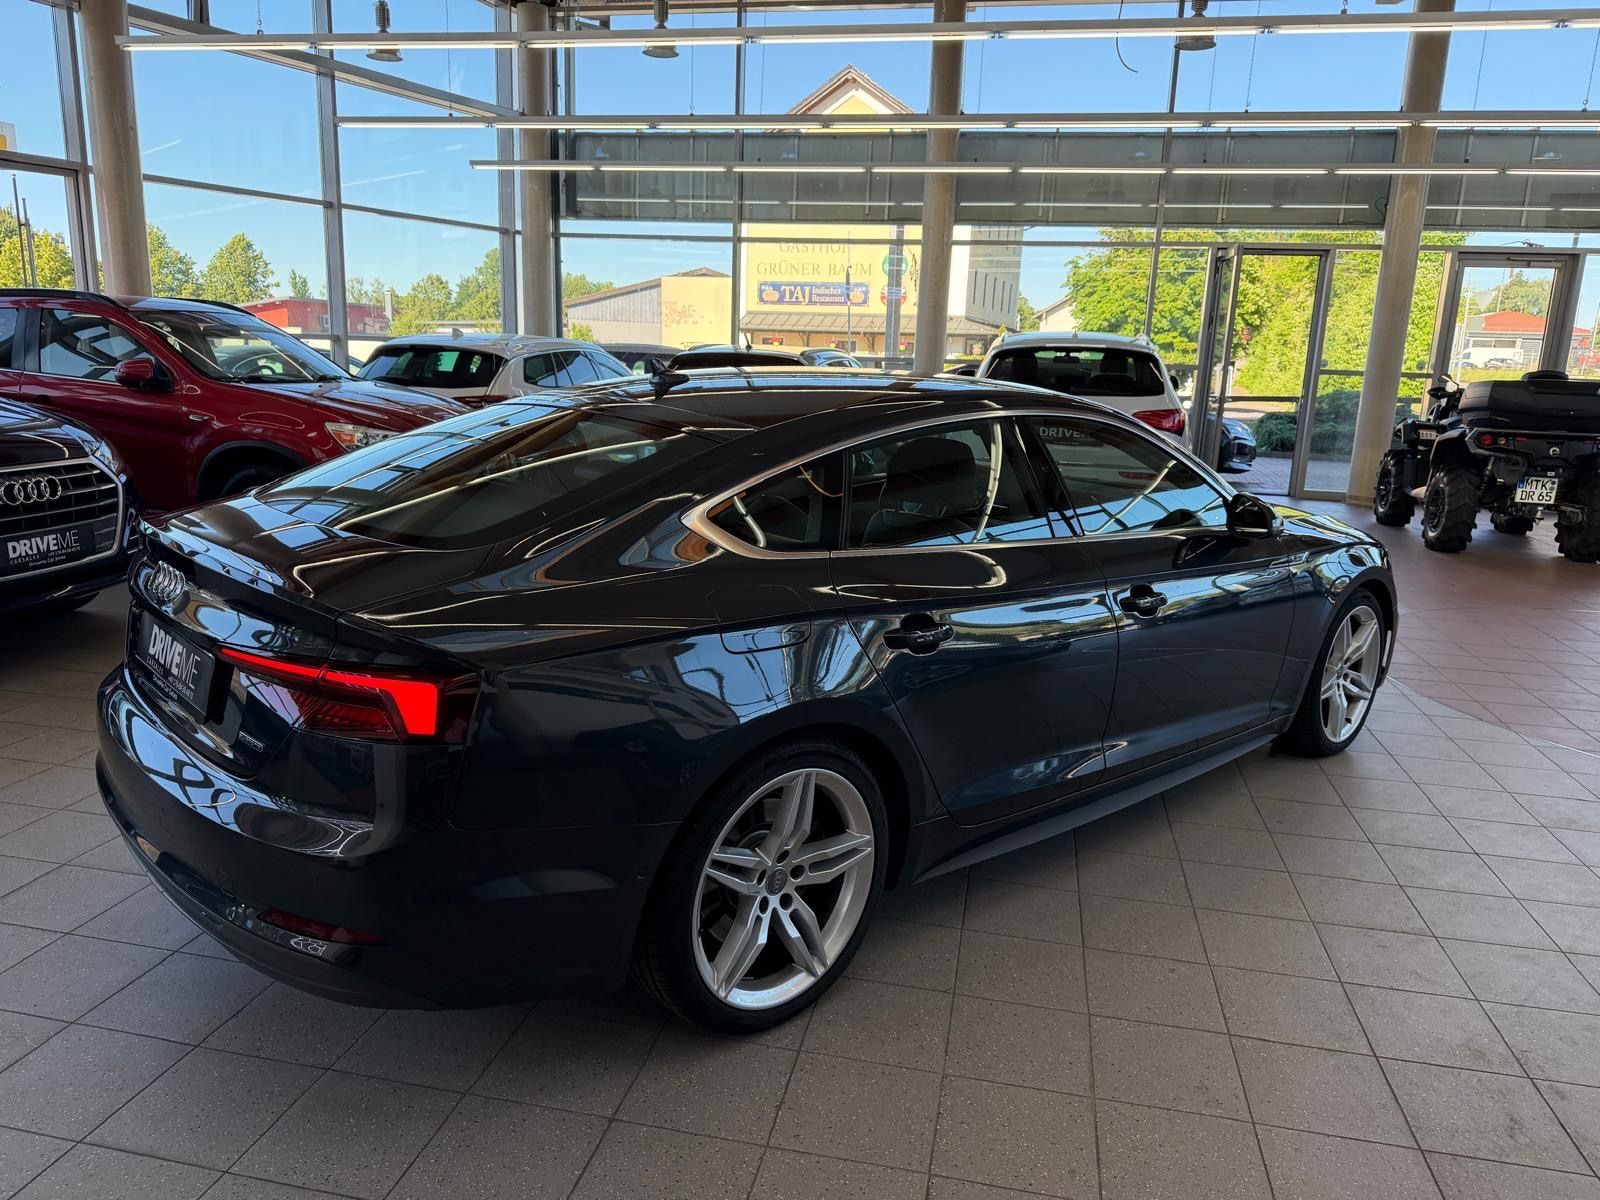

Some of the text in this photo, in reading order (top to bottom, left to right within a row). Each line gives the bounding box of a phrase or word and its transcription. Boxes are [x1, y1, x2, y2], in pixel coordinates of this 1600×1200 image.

[757, 259, 821, 276] GRÜNER
[828, 263, 872, 276] BAUM
[781, 285, 811, 304] TAJ
[812, 286, 840, 295] Indisches
[1525, 479, 1552, 491] MTK
[1520, 490, 1553, 502] DR 65
[7, 529, 80, 559] DRIVEME
[148, 623, 201, 690] DRIVEME
